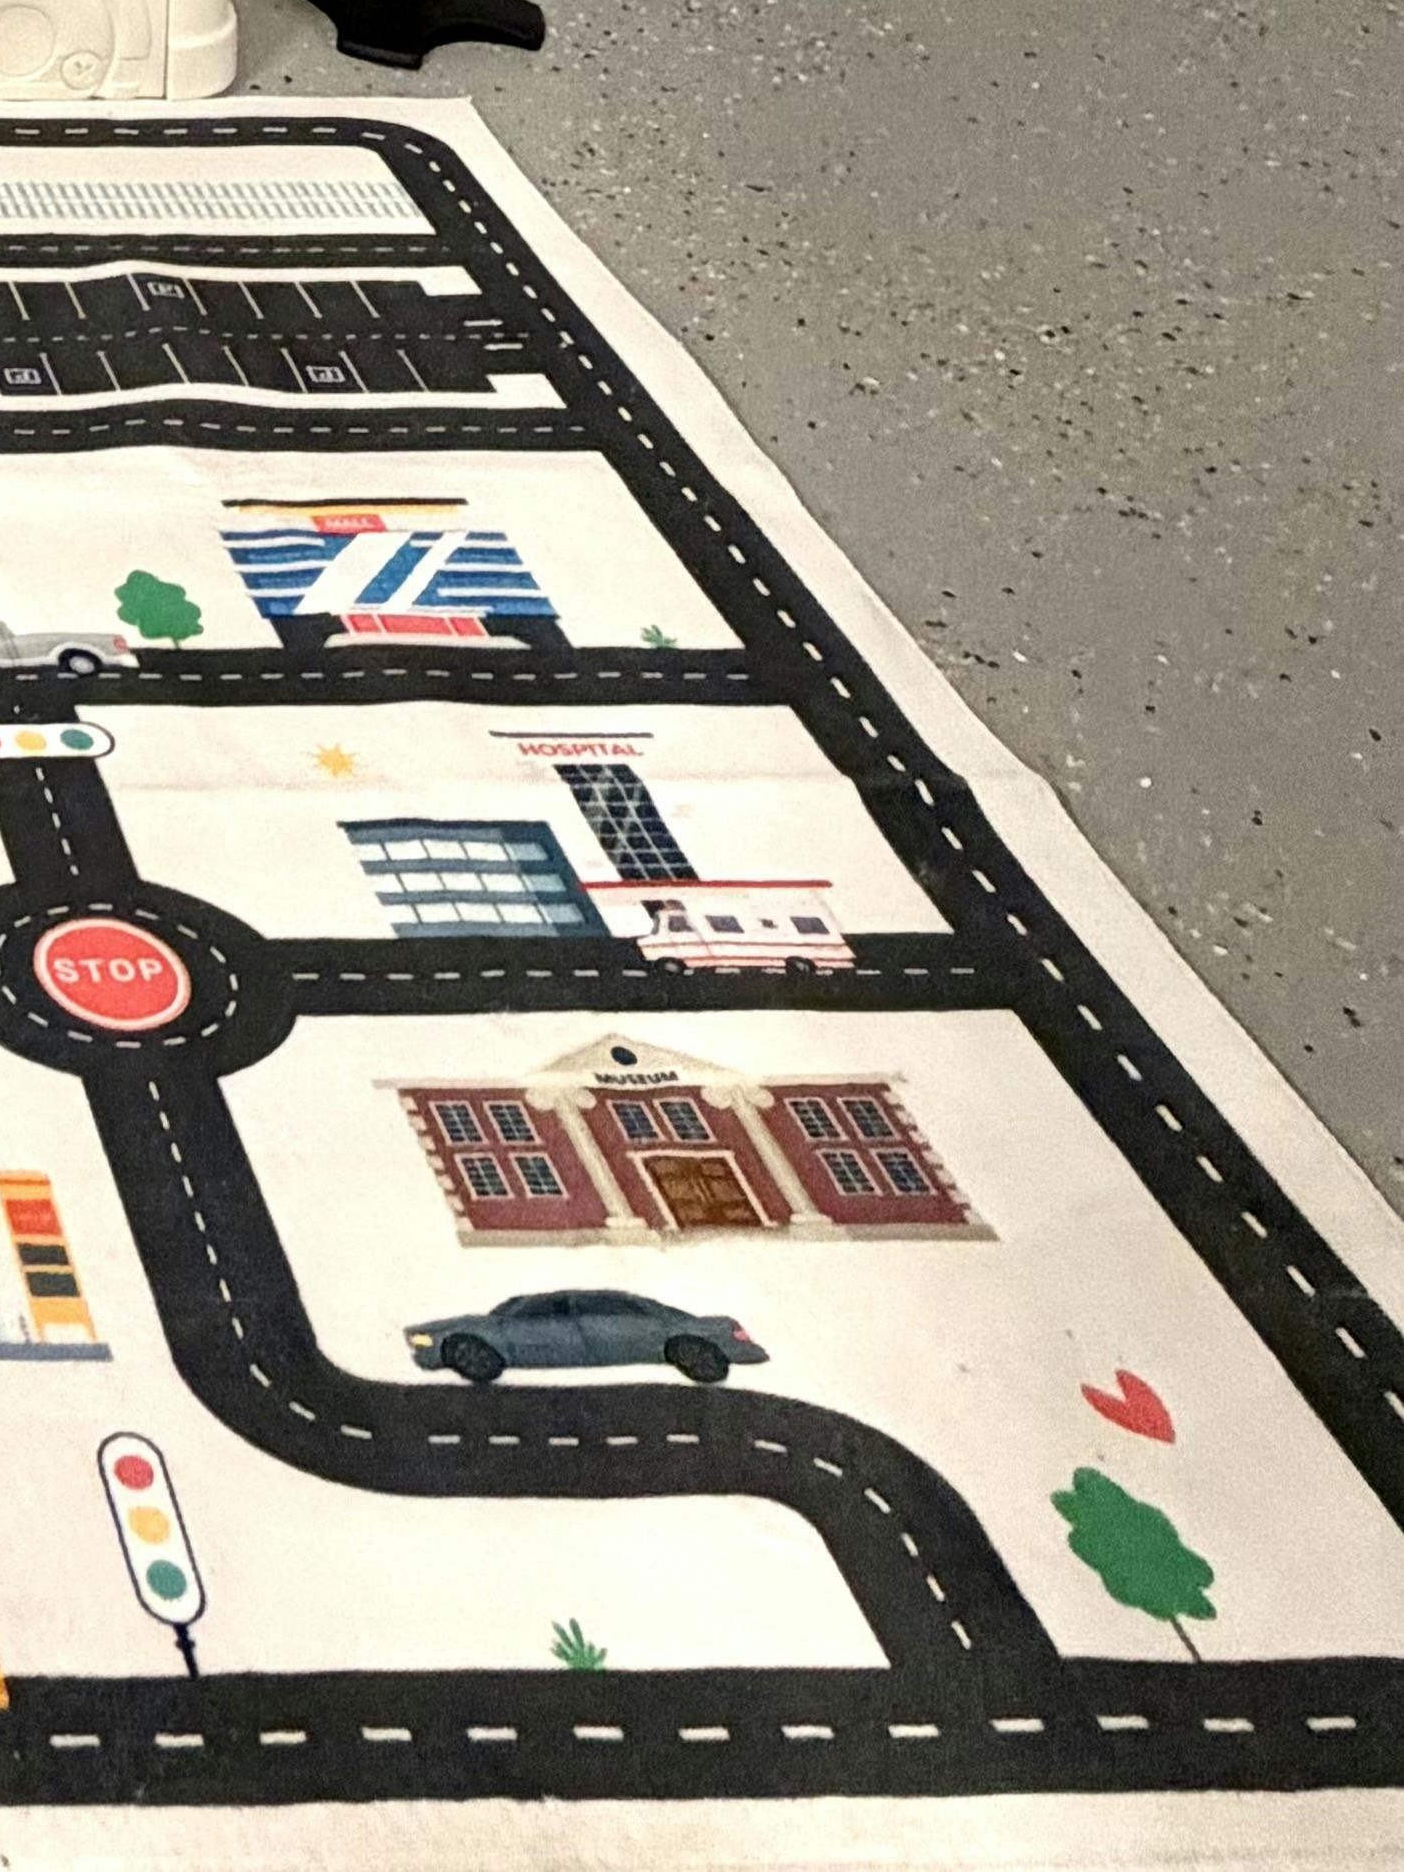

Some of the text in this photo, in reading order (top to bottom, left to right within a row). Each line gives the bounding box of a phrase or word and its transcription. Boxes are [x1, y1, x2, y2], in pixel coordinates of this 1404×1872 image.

[325, 517, 374, 529] MALL
[517, 742, 643, 757] HOSPITAL
[52, 955, 164, 985] STOP
[593, 1070, 679, 1085] MUSEUM
